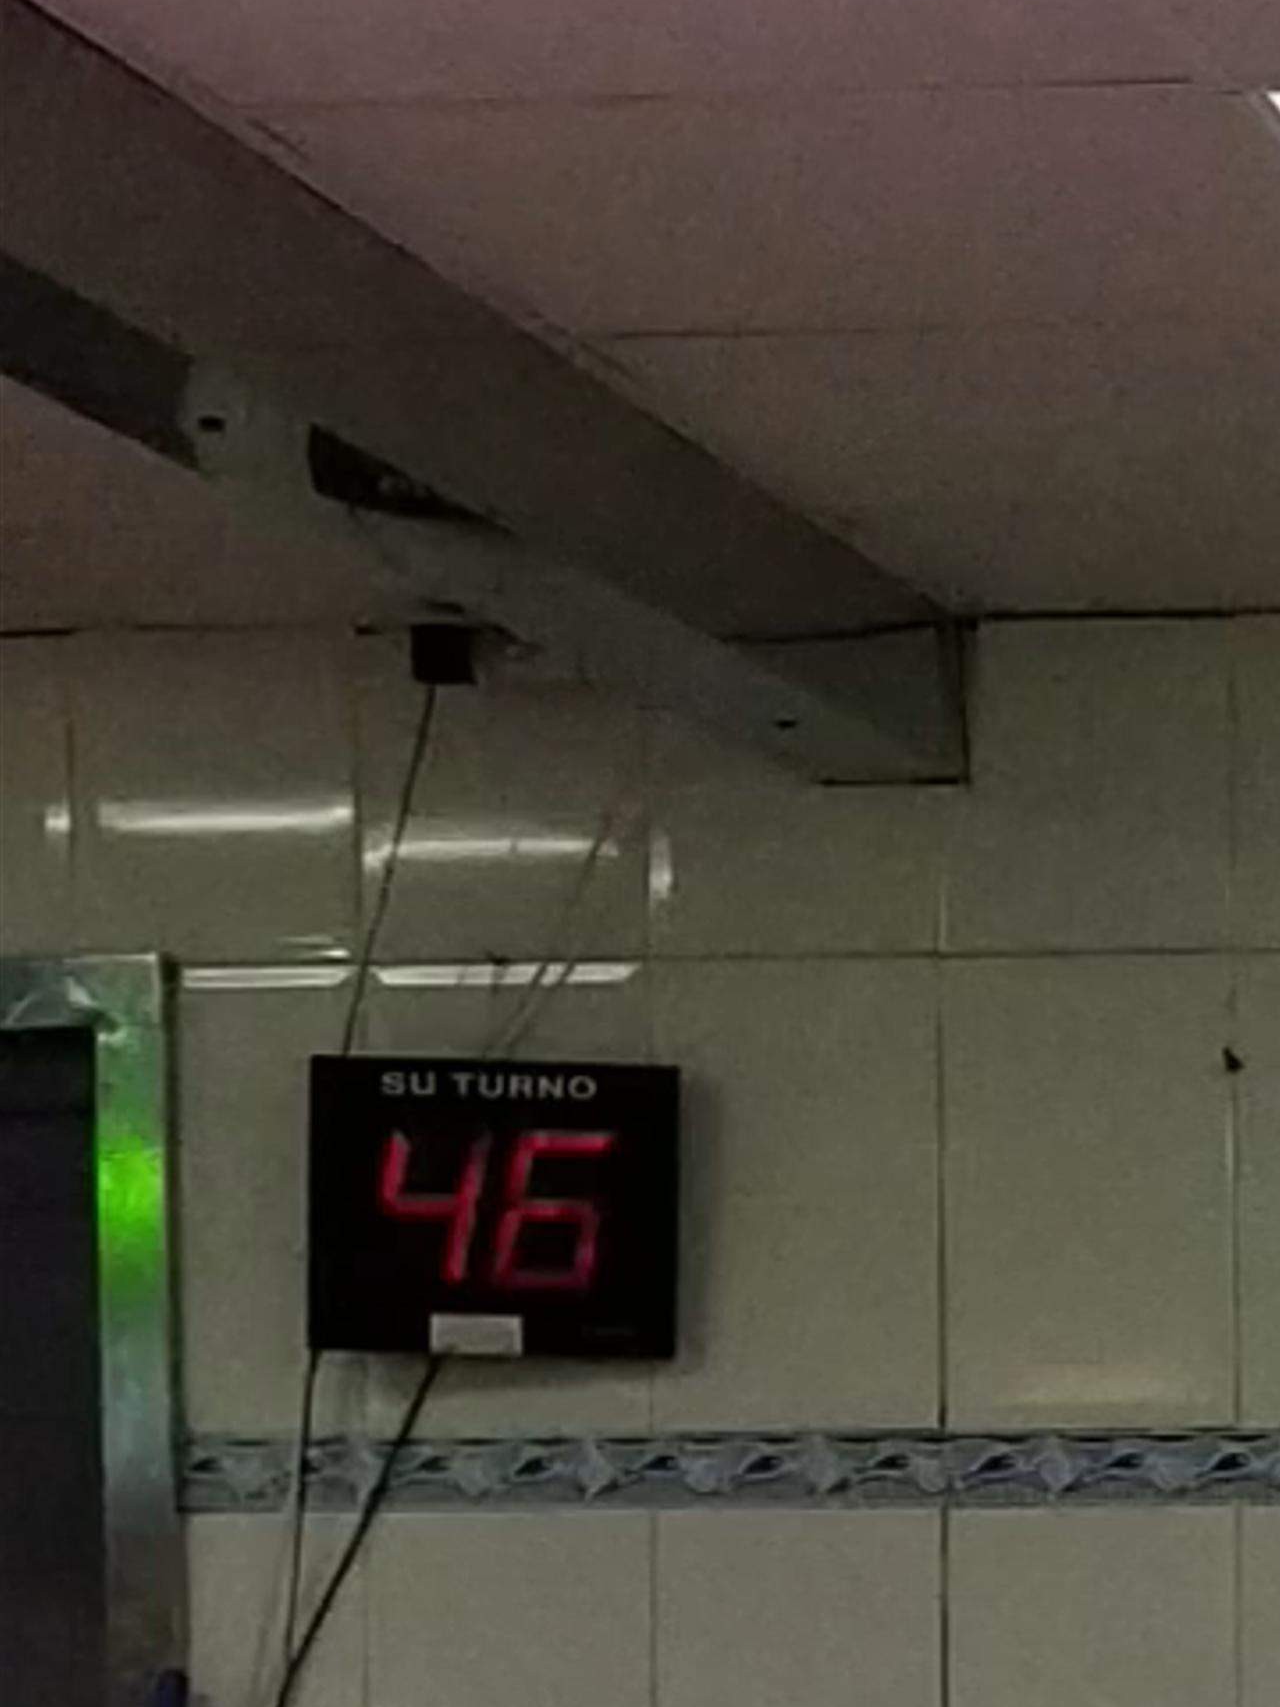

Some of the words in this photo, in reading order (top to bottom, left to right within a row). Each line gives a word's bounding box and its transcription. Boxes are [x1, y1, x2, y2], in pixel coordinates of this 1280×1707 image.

[380, 1070, 437, 1095] SU
[451, 1072, 598, 1099] TURNO
[376, 1129, 618, 1289] 46
